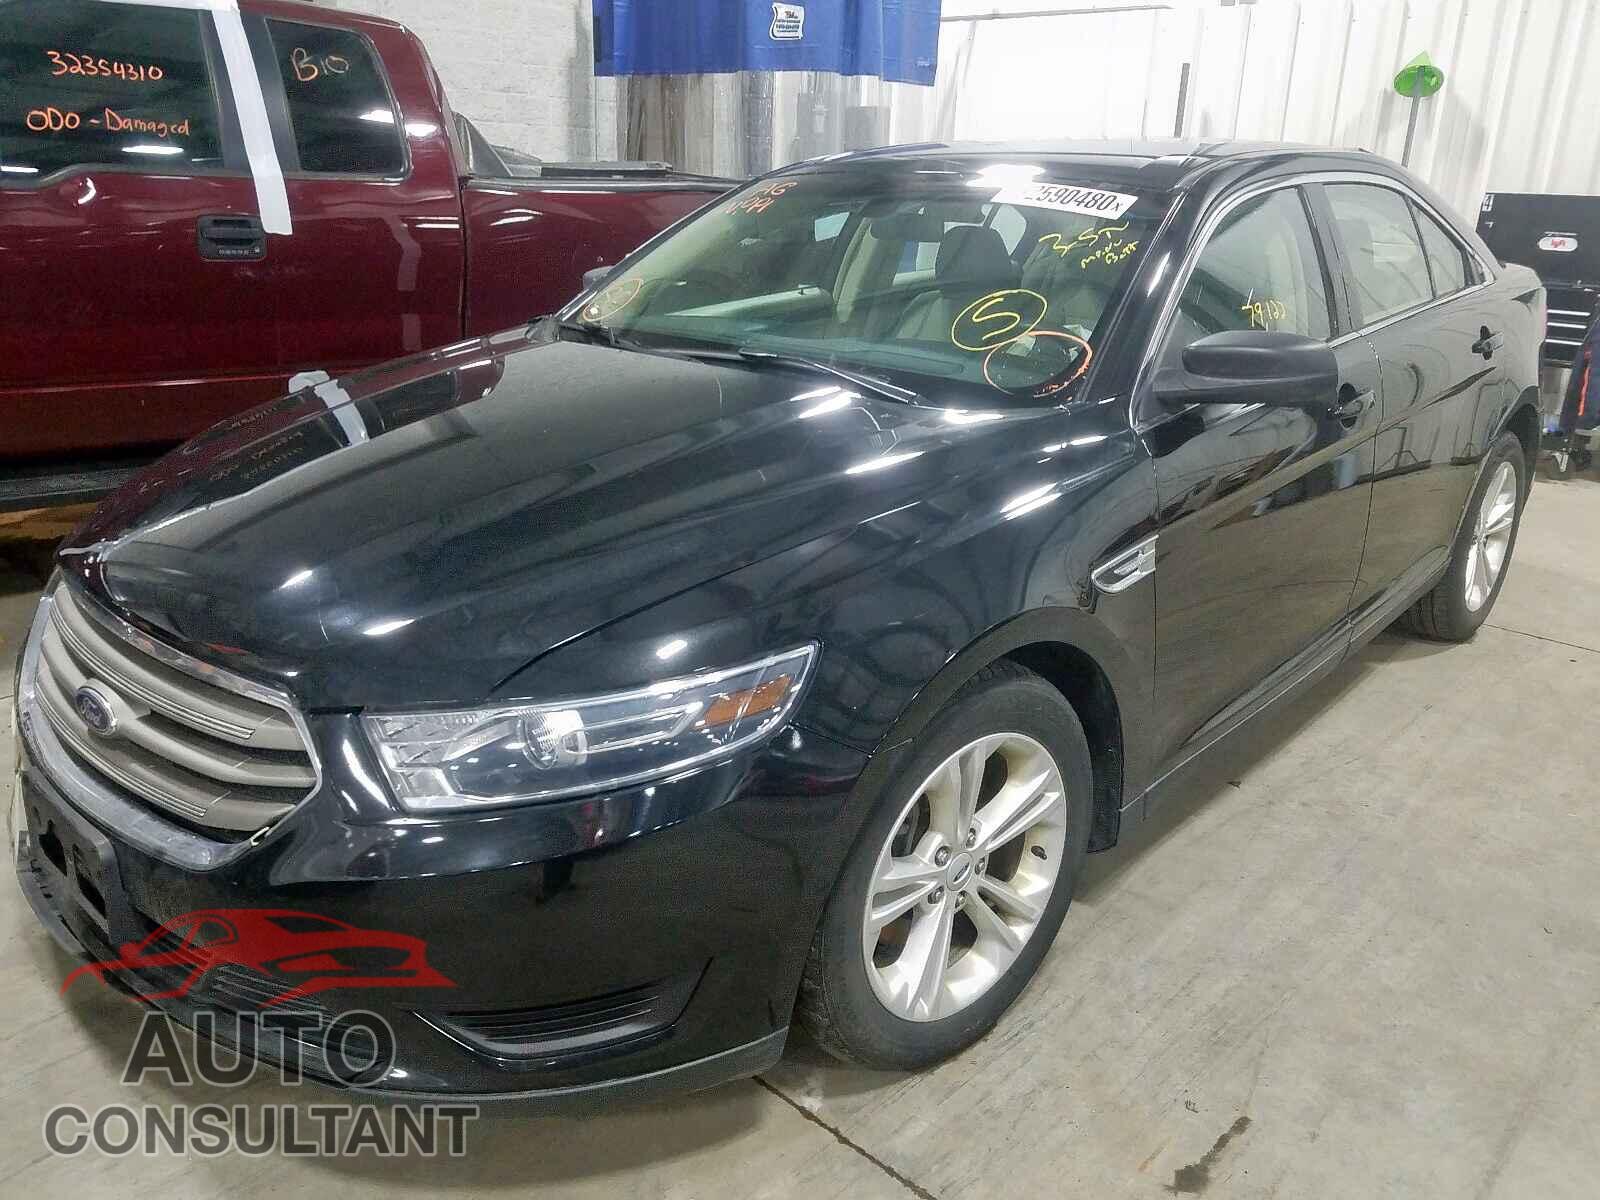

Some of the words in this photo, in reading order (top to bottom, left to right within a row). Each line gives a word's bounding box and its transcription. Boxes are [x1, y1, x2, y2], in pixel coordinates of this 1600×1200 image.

[47, 50, 164, 82] 32354310
[290, 47, 350, 82] B10
[25, 107, 81, 132] ODO
[103, 107, 191, 138] Damaged
[80, 696, 103, 727] Ford
